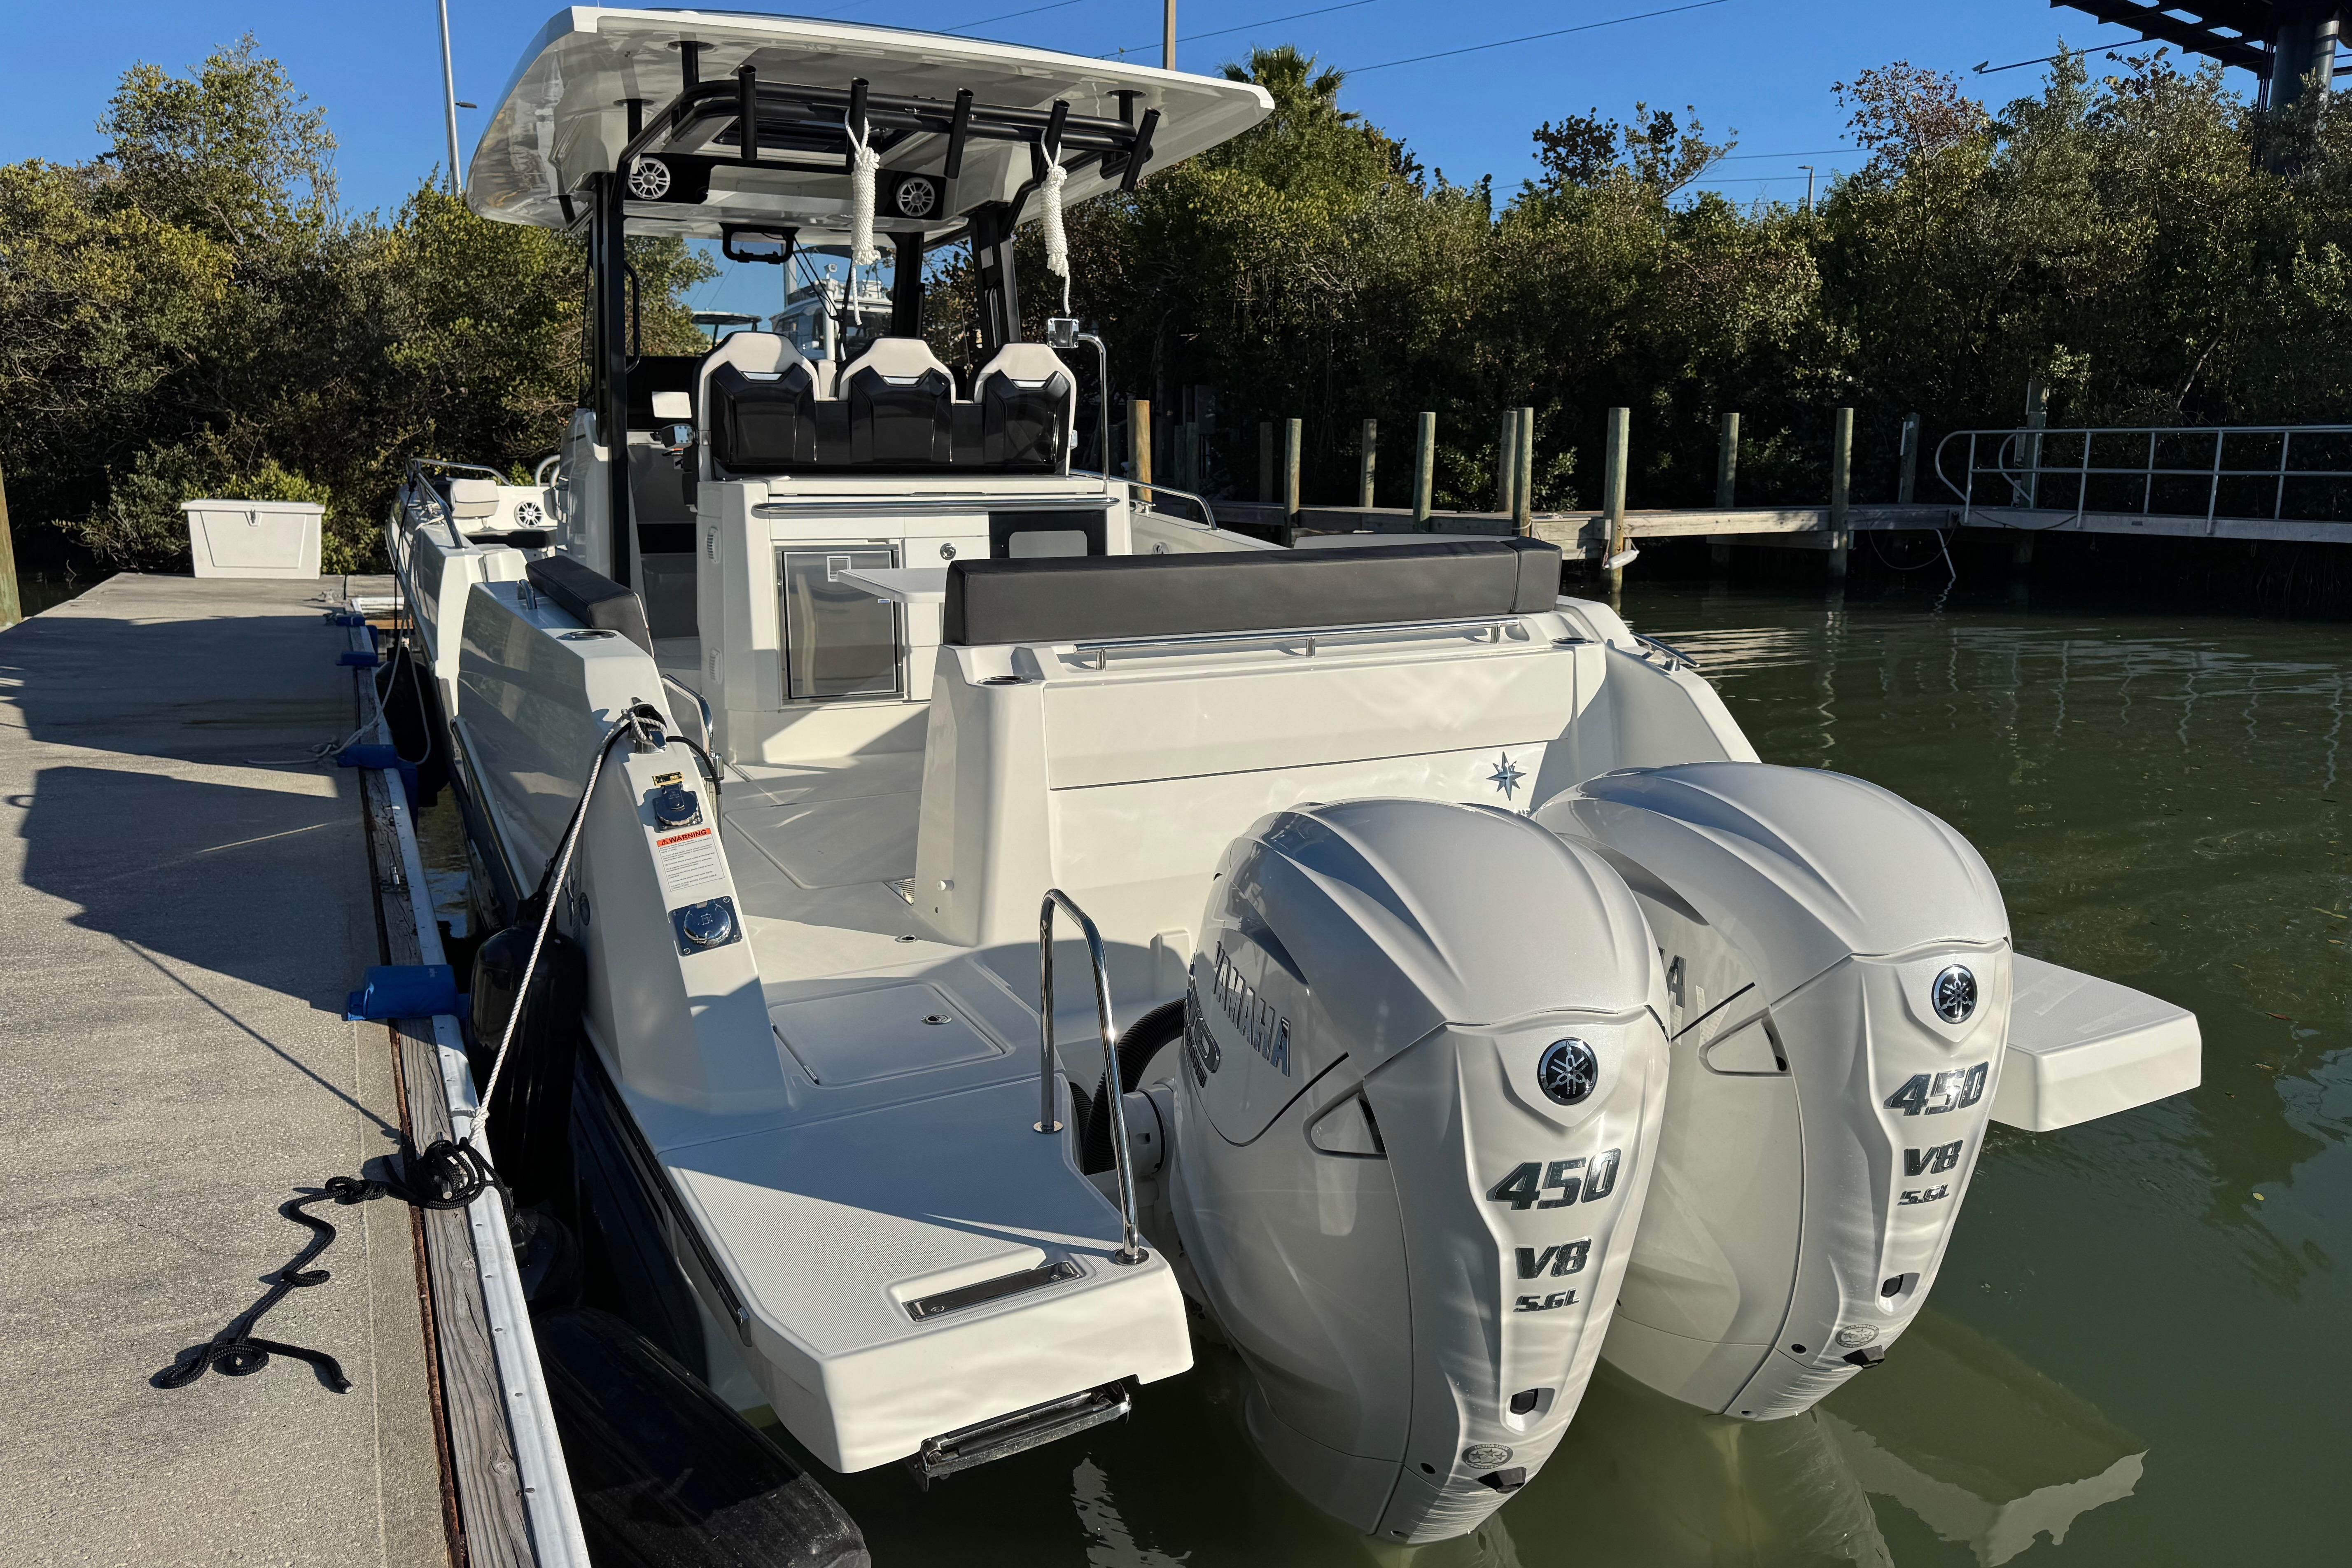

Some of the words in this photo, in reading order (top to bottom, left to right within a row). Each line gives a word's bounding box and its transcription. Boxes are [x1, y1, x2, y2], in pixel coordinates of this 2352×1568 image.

[669, 830, 707, 843] WARNING
[1212, 940, 1291, 1077] YAMAHA
[1883, 1061, 1989, 1116] 450
[1904, 1140, 1963, 1177] V8
[1486, 1148, 1621, 1210] 450
[1897, 1183, 1949, 1206] 5.6L
[1514, 1237, 1592, 1279] V8
[1513, 1288, 1580, 1312] 5.6L
